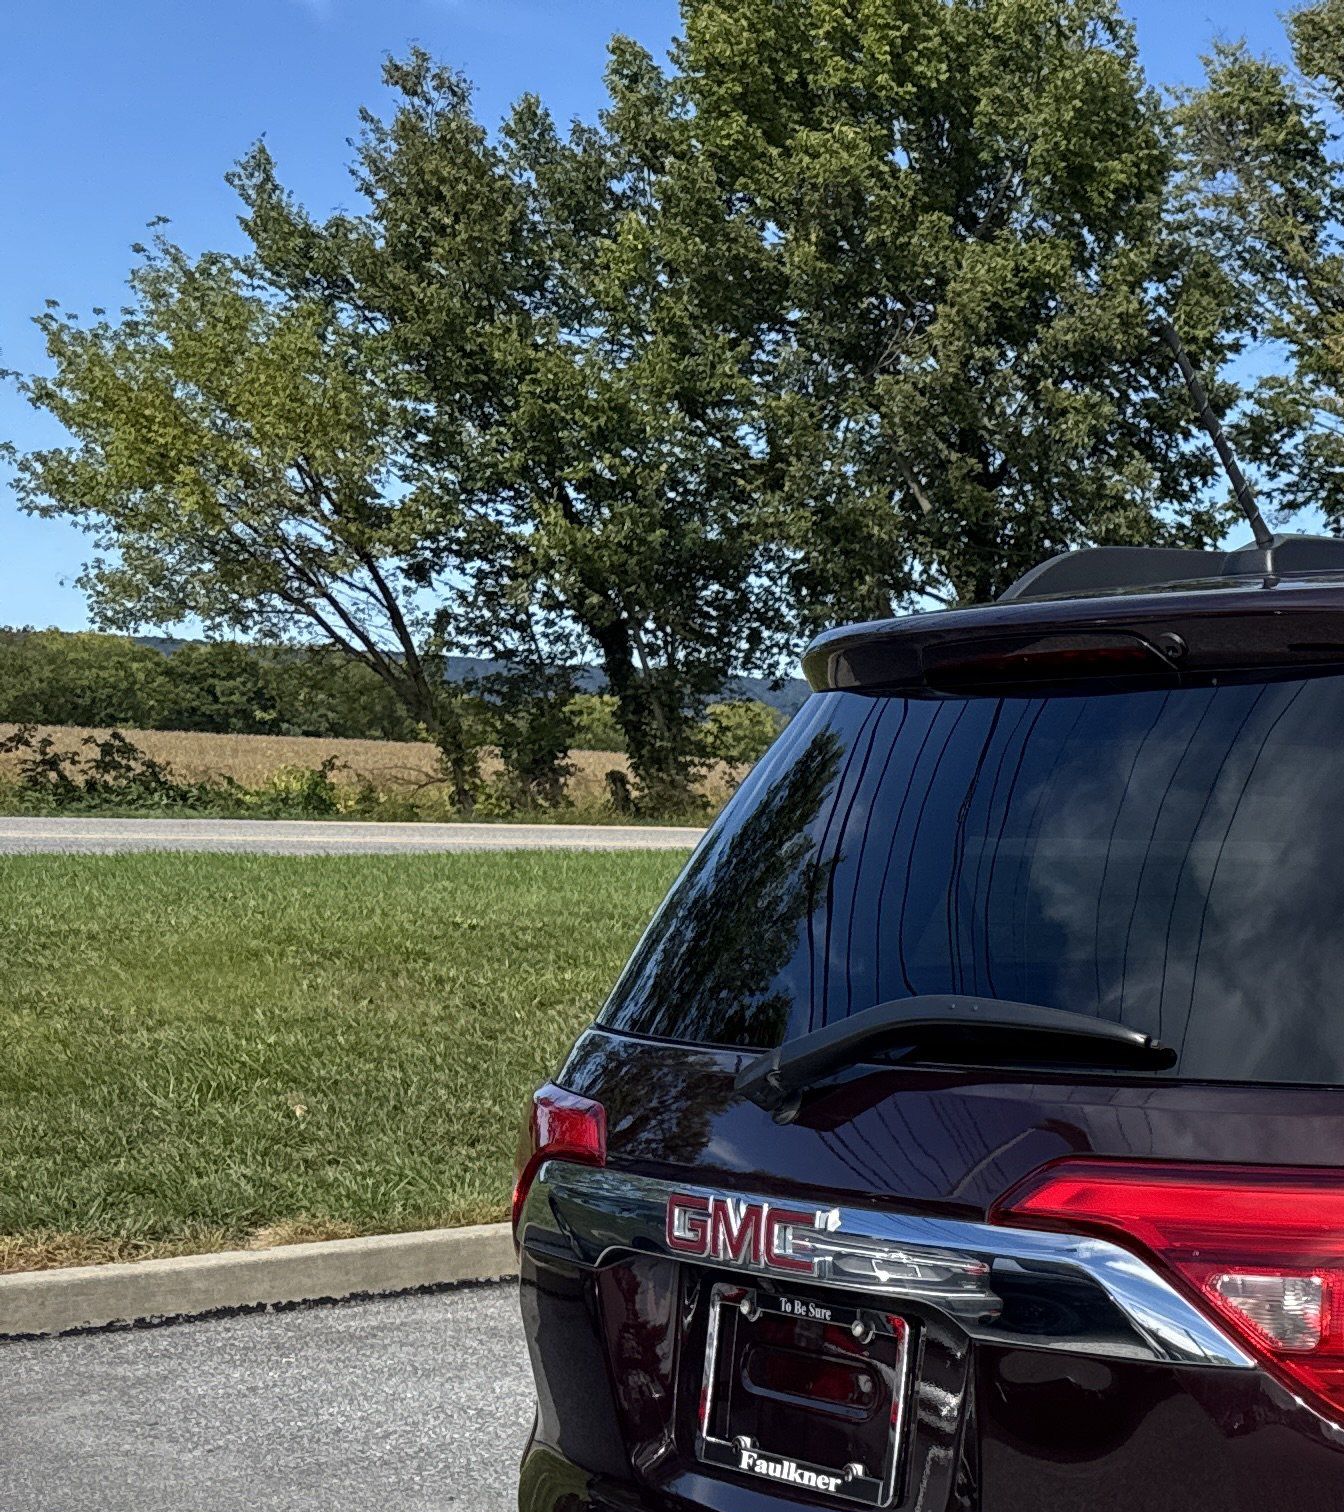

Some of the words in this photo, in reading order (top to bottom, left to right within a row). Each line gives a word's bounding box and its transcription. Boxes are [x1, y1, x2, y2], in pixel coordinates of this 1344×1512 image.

[665, 1193, 819, 1277] GMC
[780, 1297, 792, 1313] To
[794, 1299, 807, 1316] Be
[808, 1302, 832, 1321] Sure
[738, 1449, 842, 1493] Faulkner
